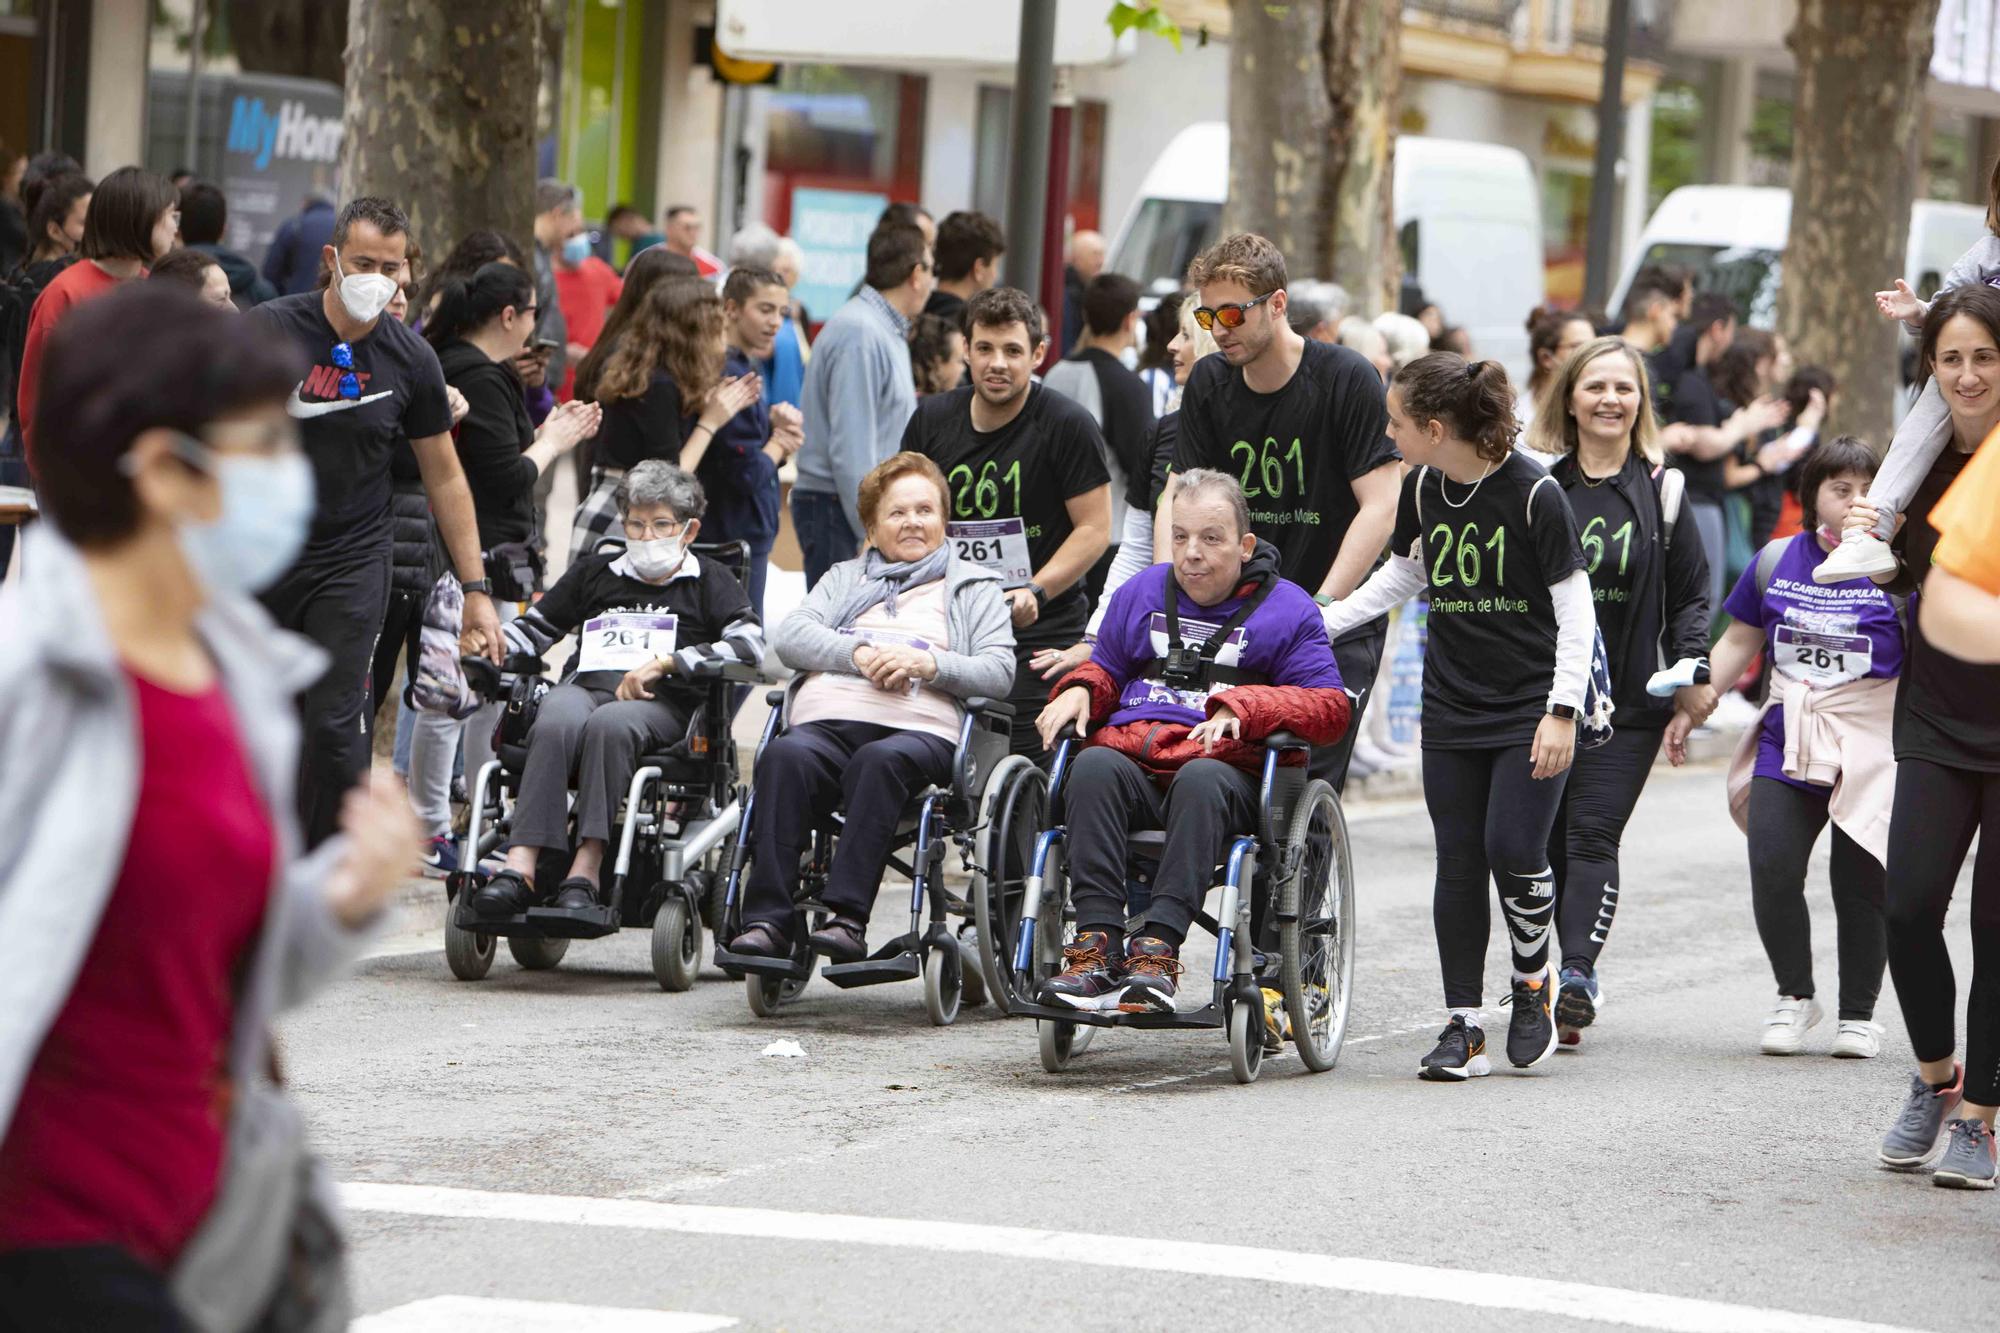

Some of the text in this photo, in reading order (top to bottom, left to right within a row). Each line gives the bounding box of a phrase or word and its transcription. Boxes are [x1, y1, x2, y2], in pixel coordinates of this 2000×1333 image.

[303, 364, 371, 399] NIE
[1230, 436, 1305, 498] 261
[948, 460, 1021, 518] 261
[957, 538, 1003, 561] 261
[1429, 522, 1505, 587] 261
[1773, 578, 1884, 598] XIV CARRERA POPULAR
[1435, 597, 1474, 613] Primera
[1477, 598, 1491, 612] de
[602, 630, 650, 649] 261
[1796, 647, 1845, 672] 261
[1528, 881, 1552, 898] NIKE
